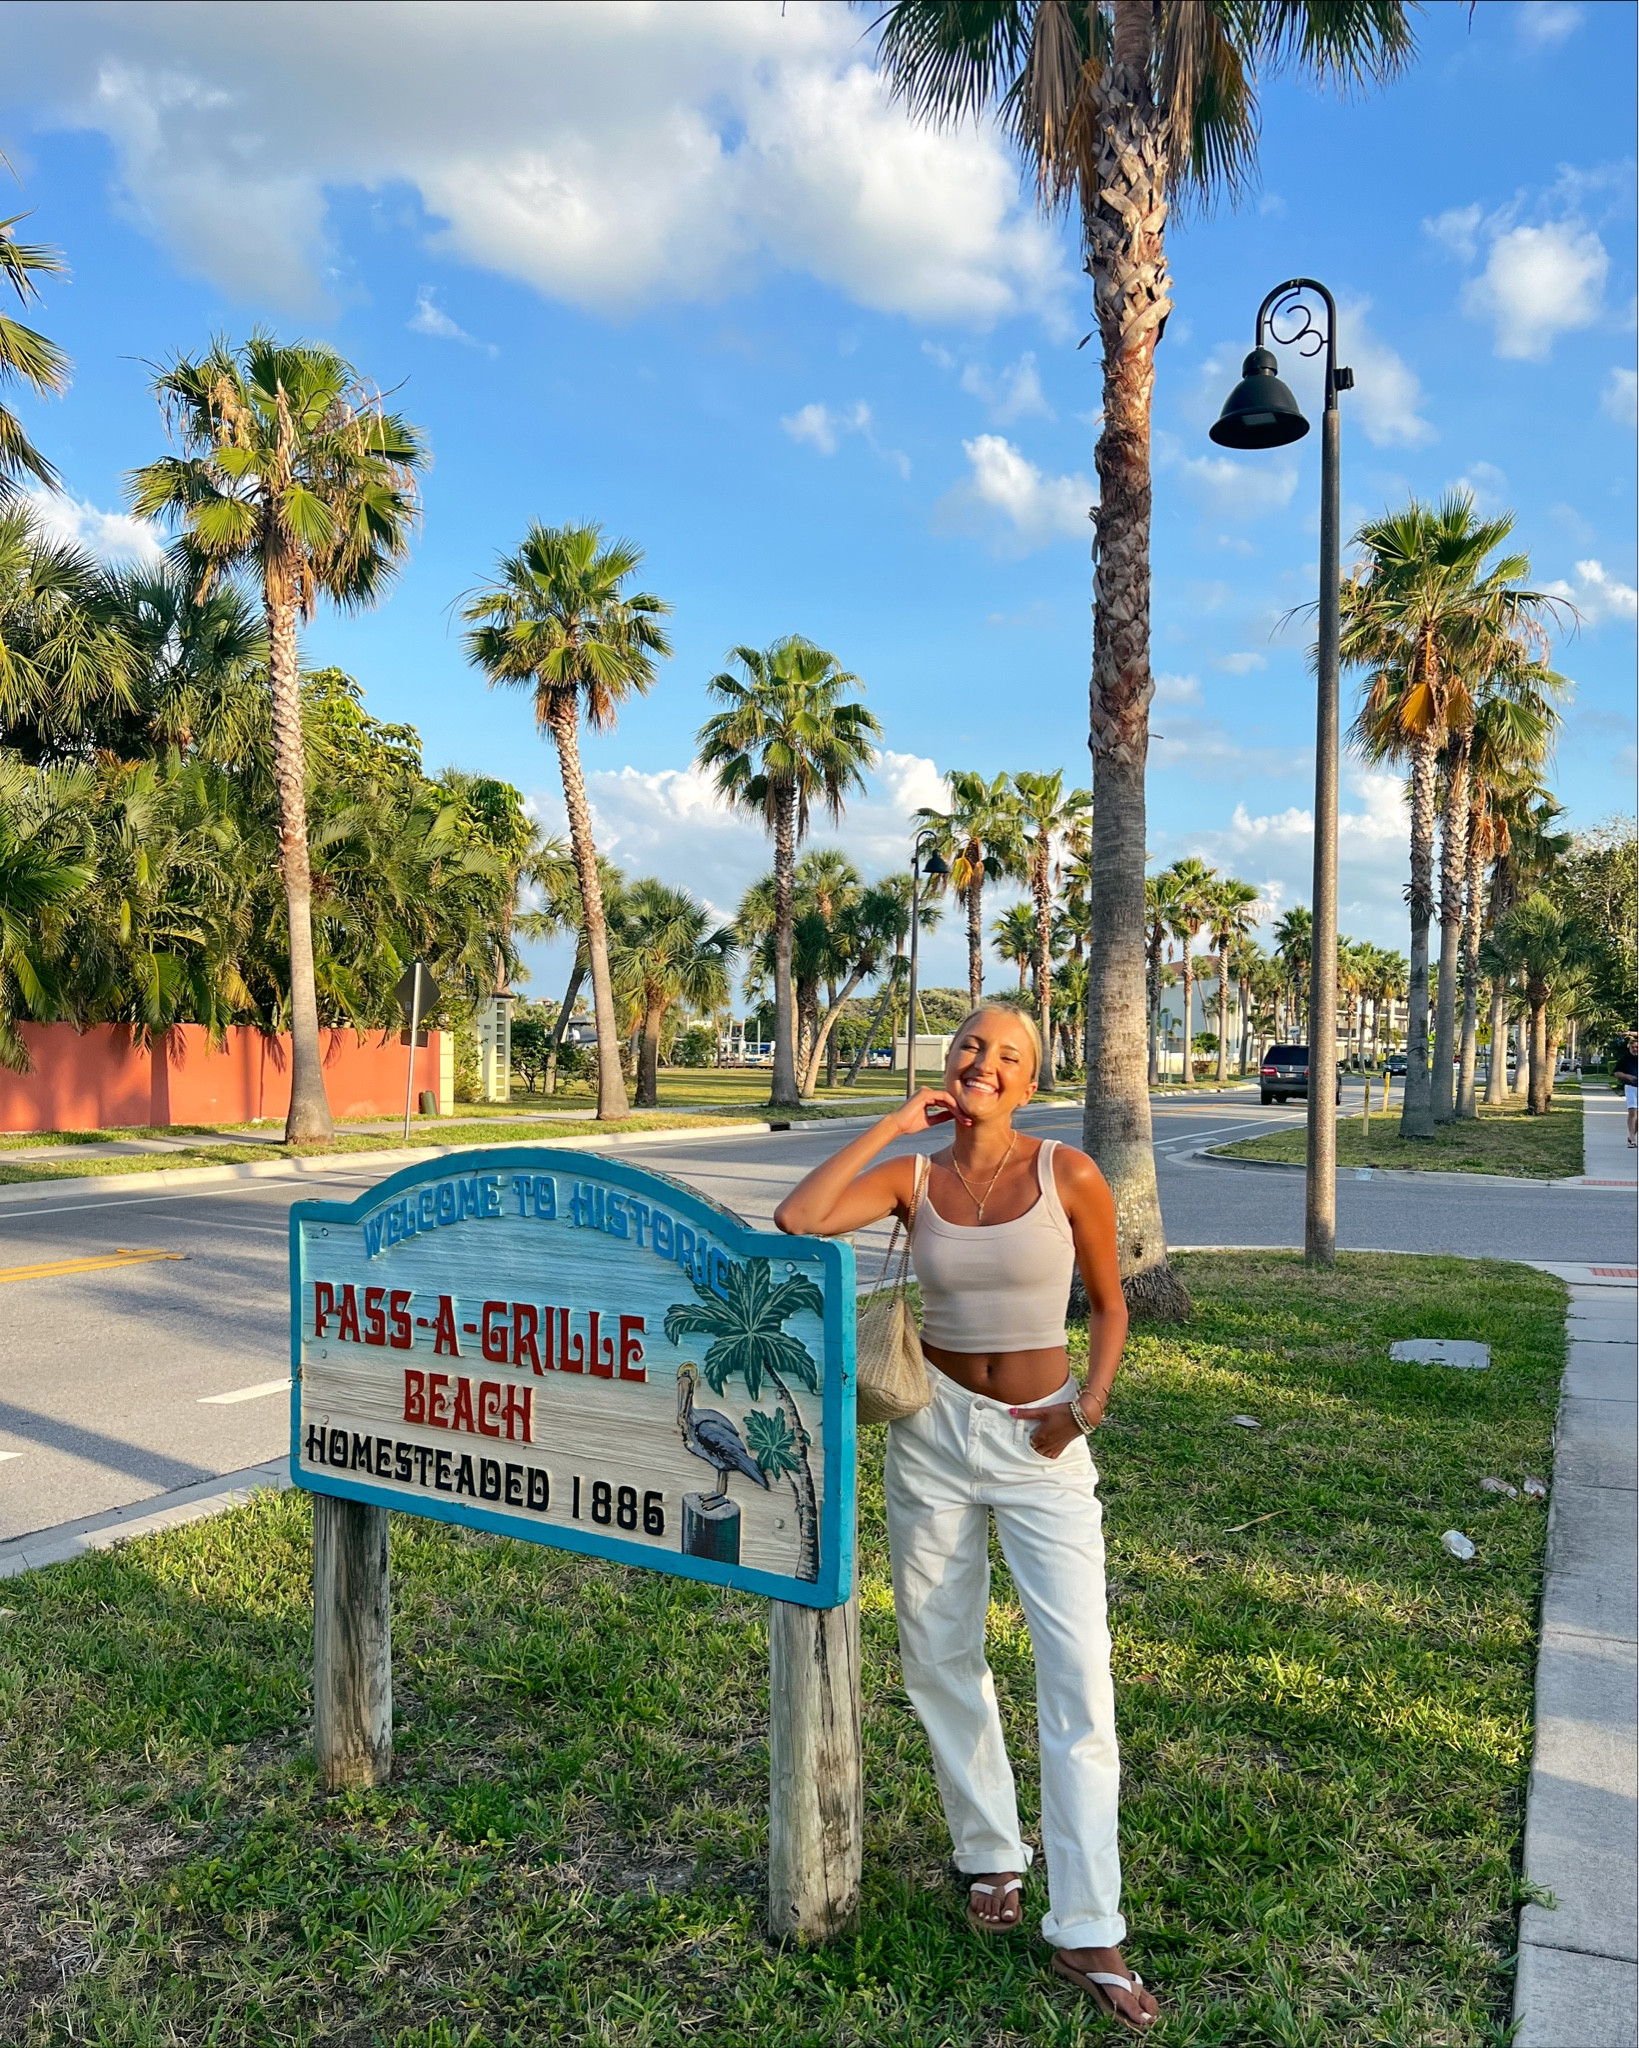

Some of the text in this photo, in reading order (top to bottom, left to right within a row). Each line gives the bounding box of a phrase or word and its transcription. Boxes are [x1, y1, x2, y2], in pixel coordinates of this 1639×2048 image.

[363, 1175, 729, 1300] WELCOME TO HISTORIC
[315, 1281, 648, 1382] PASS-A-GRILLE
[404, 1369, 533, 1442] BEACH
[306, 1424, 665, 1535] HOMESTEADED 1886
